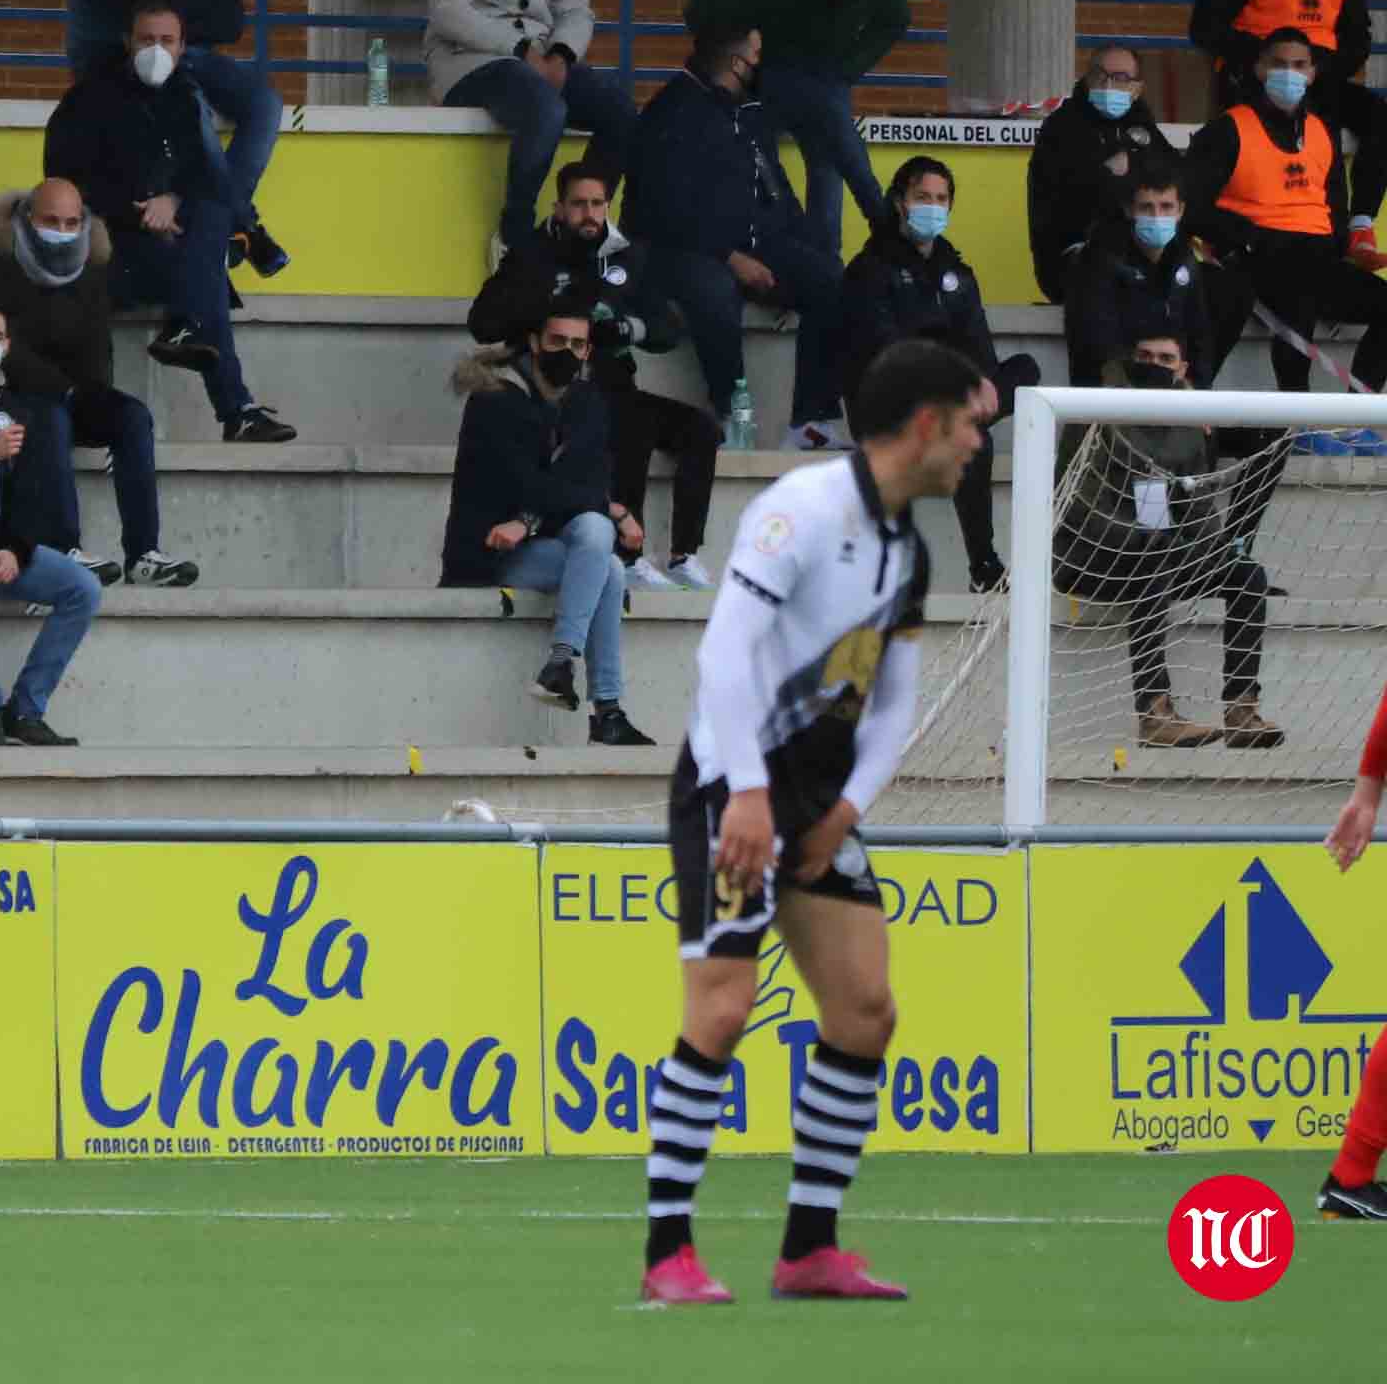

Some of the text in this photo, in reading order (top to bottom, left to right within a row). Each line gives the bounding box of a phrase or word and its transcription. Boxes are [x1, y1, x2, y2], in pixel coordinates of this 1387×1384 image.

[870, 124, 958, 142] PERSONAL
[964, 126, 995, 143] DEL
[235, 855, 369, 1017] La
[81, 966, 518, 1129] Charra
[1112, 1105, 1354, 1143] Abogado Ges
[84, 1137, 149, 1153] FABRICA
[154, 1137, 174, 1153] DE
[228, 1137, 325, 1153] DETERGENTES
[337, 1137, 431, 1153] PRODUCTOS
[436, 1137, 455, 1153] DE
[459, 1137, 524, 1153] PISCINAS
